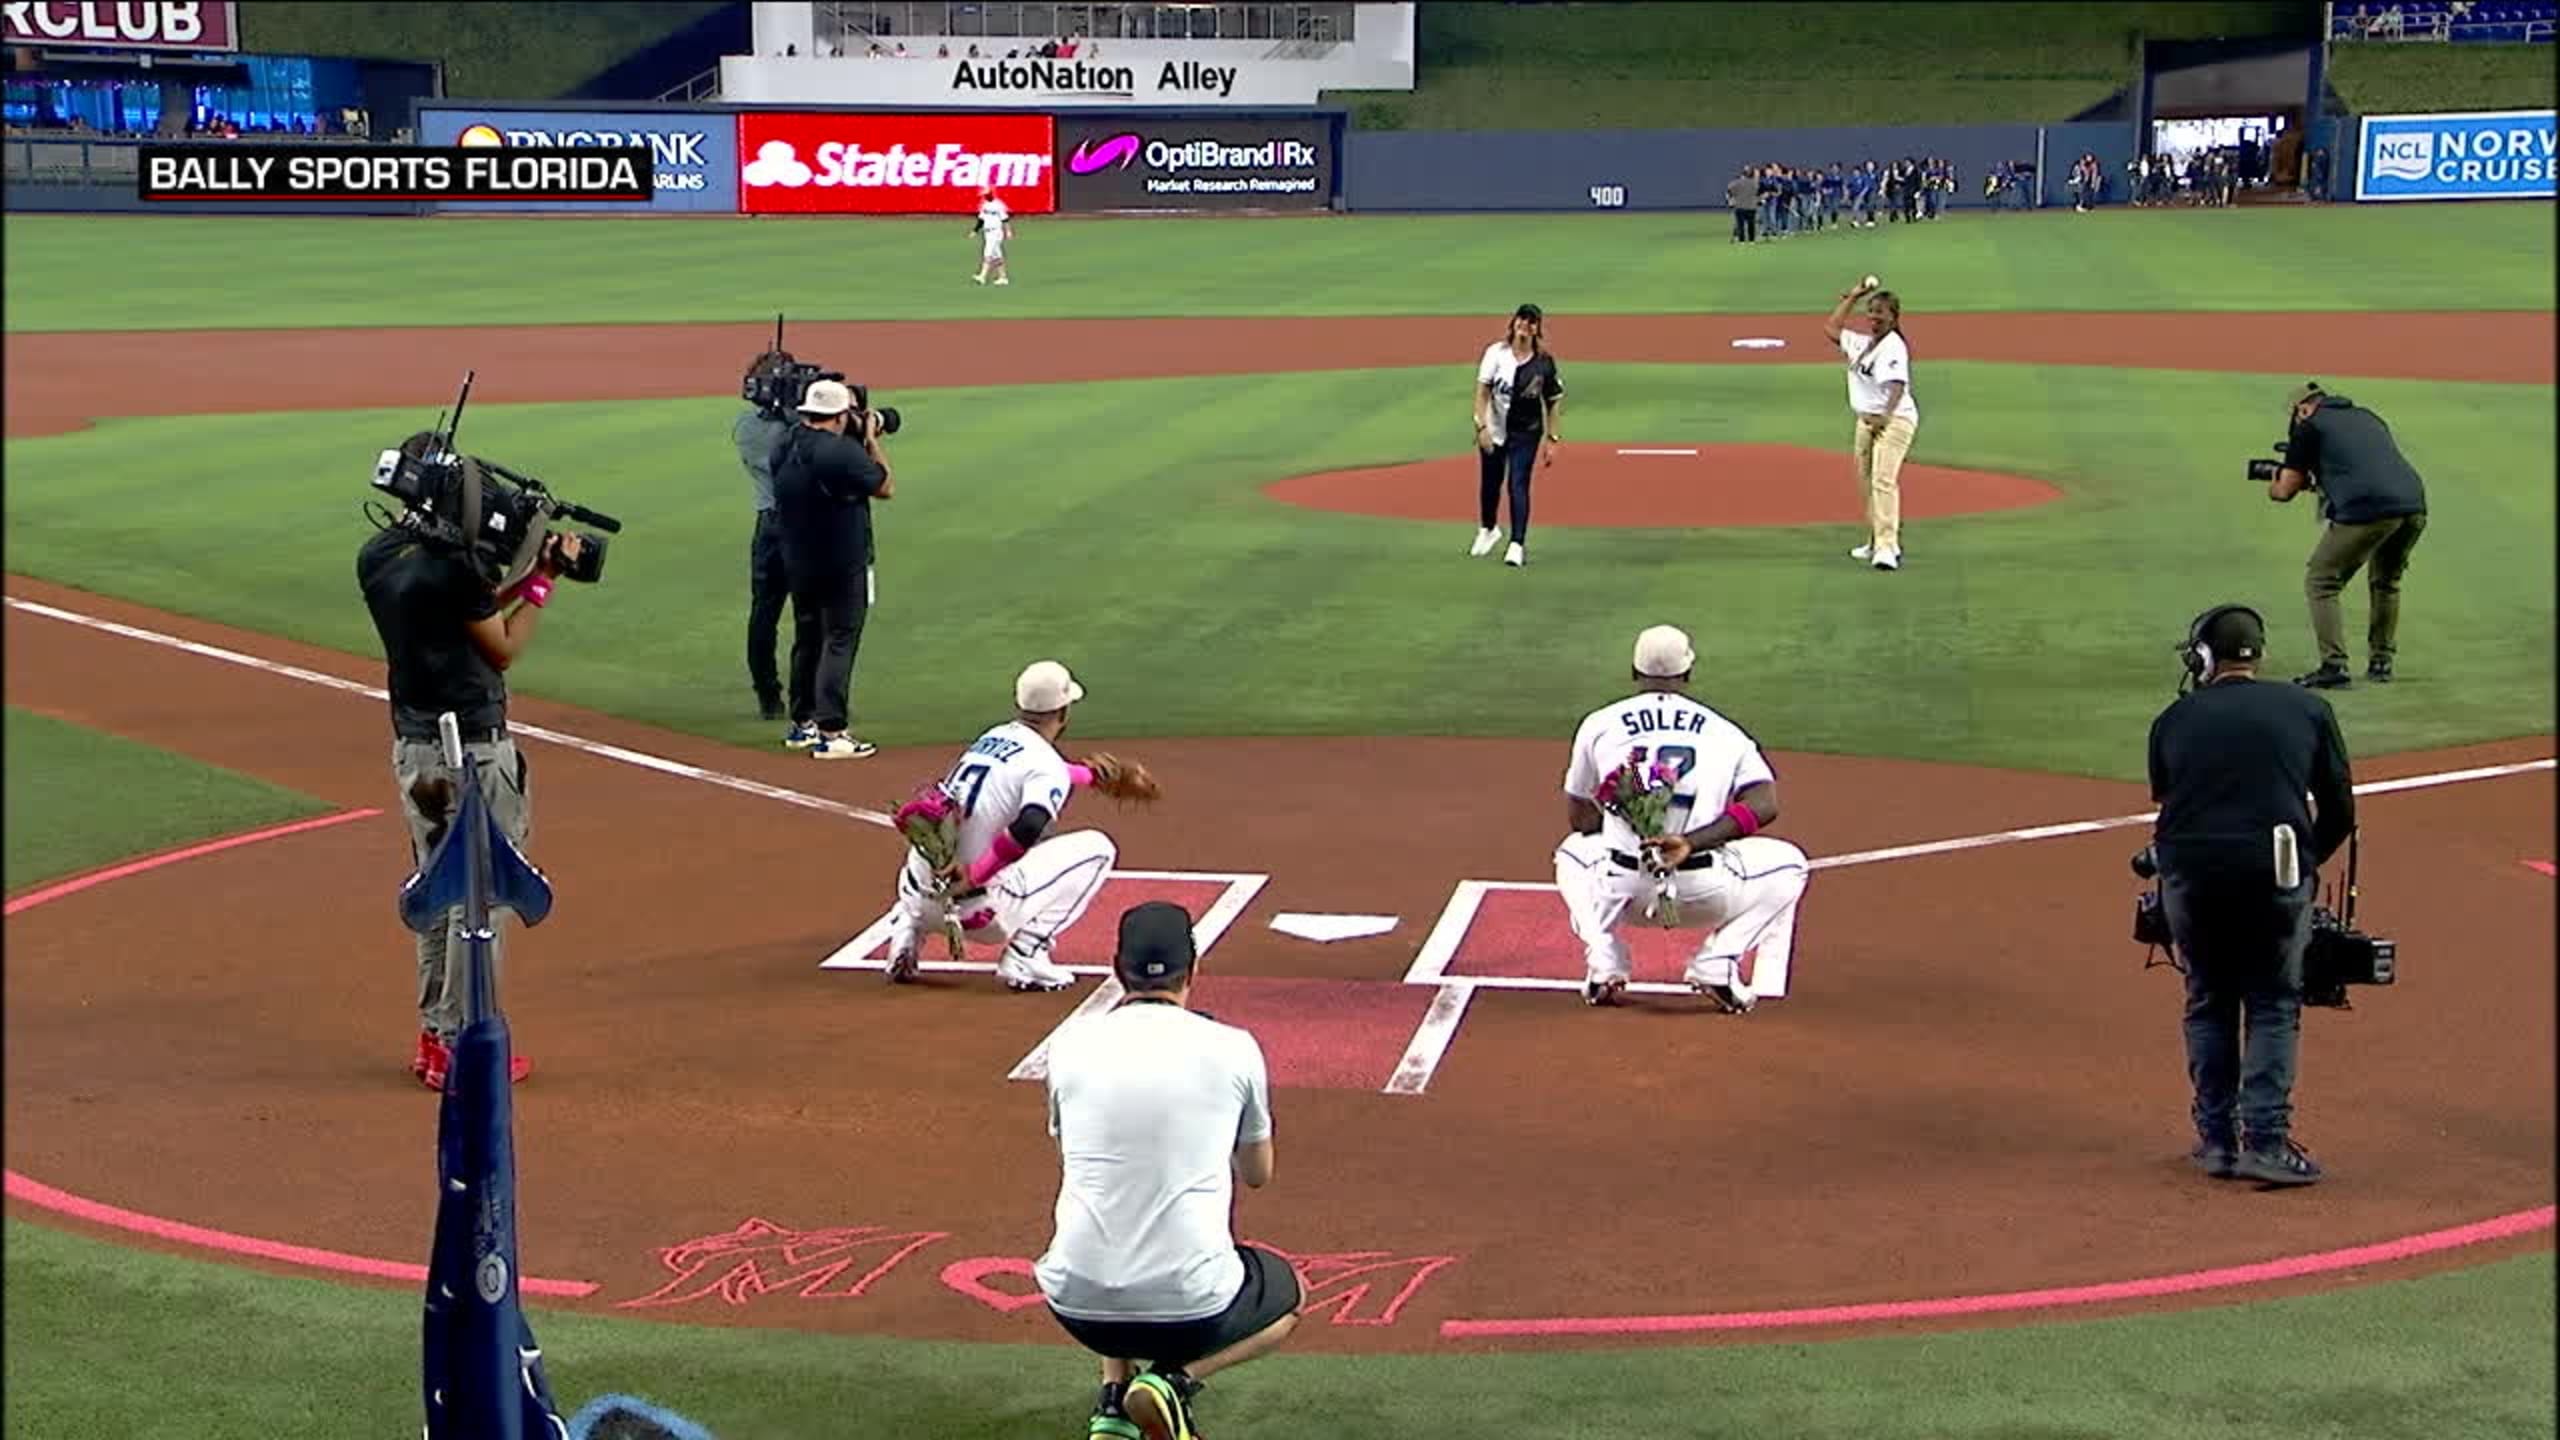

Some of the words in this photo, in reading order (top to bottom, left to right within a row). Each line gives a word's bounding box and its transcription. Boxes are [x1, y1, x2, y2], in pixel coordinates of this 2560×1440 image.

[952, 60, 1134, 90] AutoNation
[1157, 61, 1237, 97] Alley
[2379, 142, 2428, 160] NCL
[1147, 179, 1191, 193] Market
[1193, 178, 1248, 192] Research
[1249, 178, 1315, 193] Reimagined
[1590, 186, 1624, 207] 400
[1620, 708, 1707, 736] SOLER
